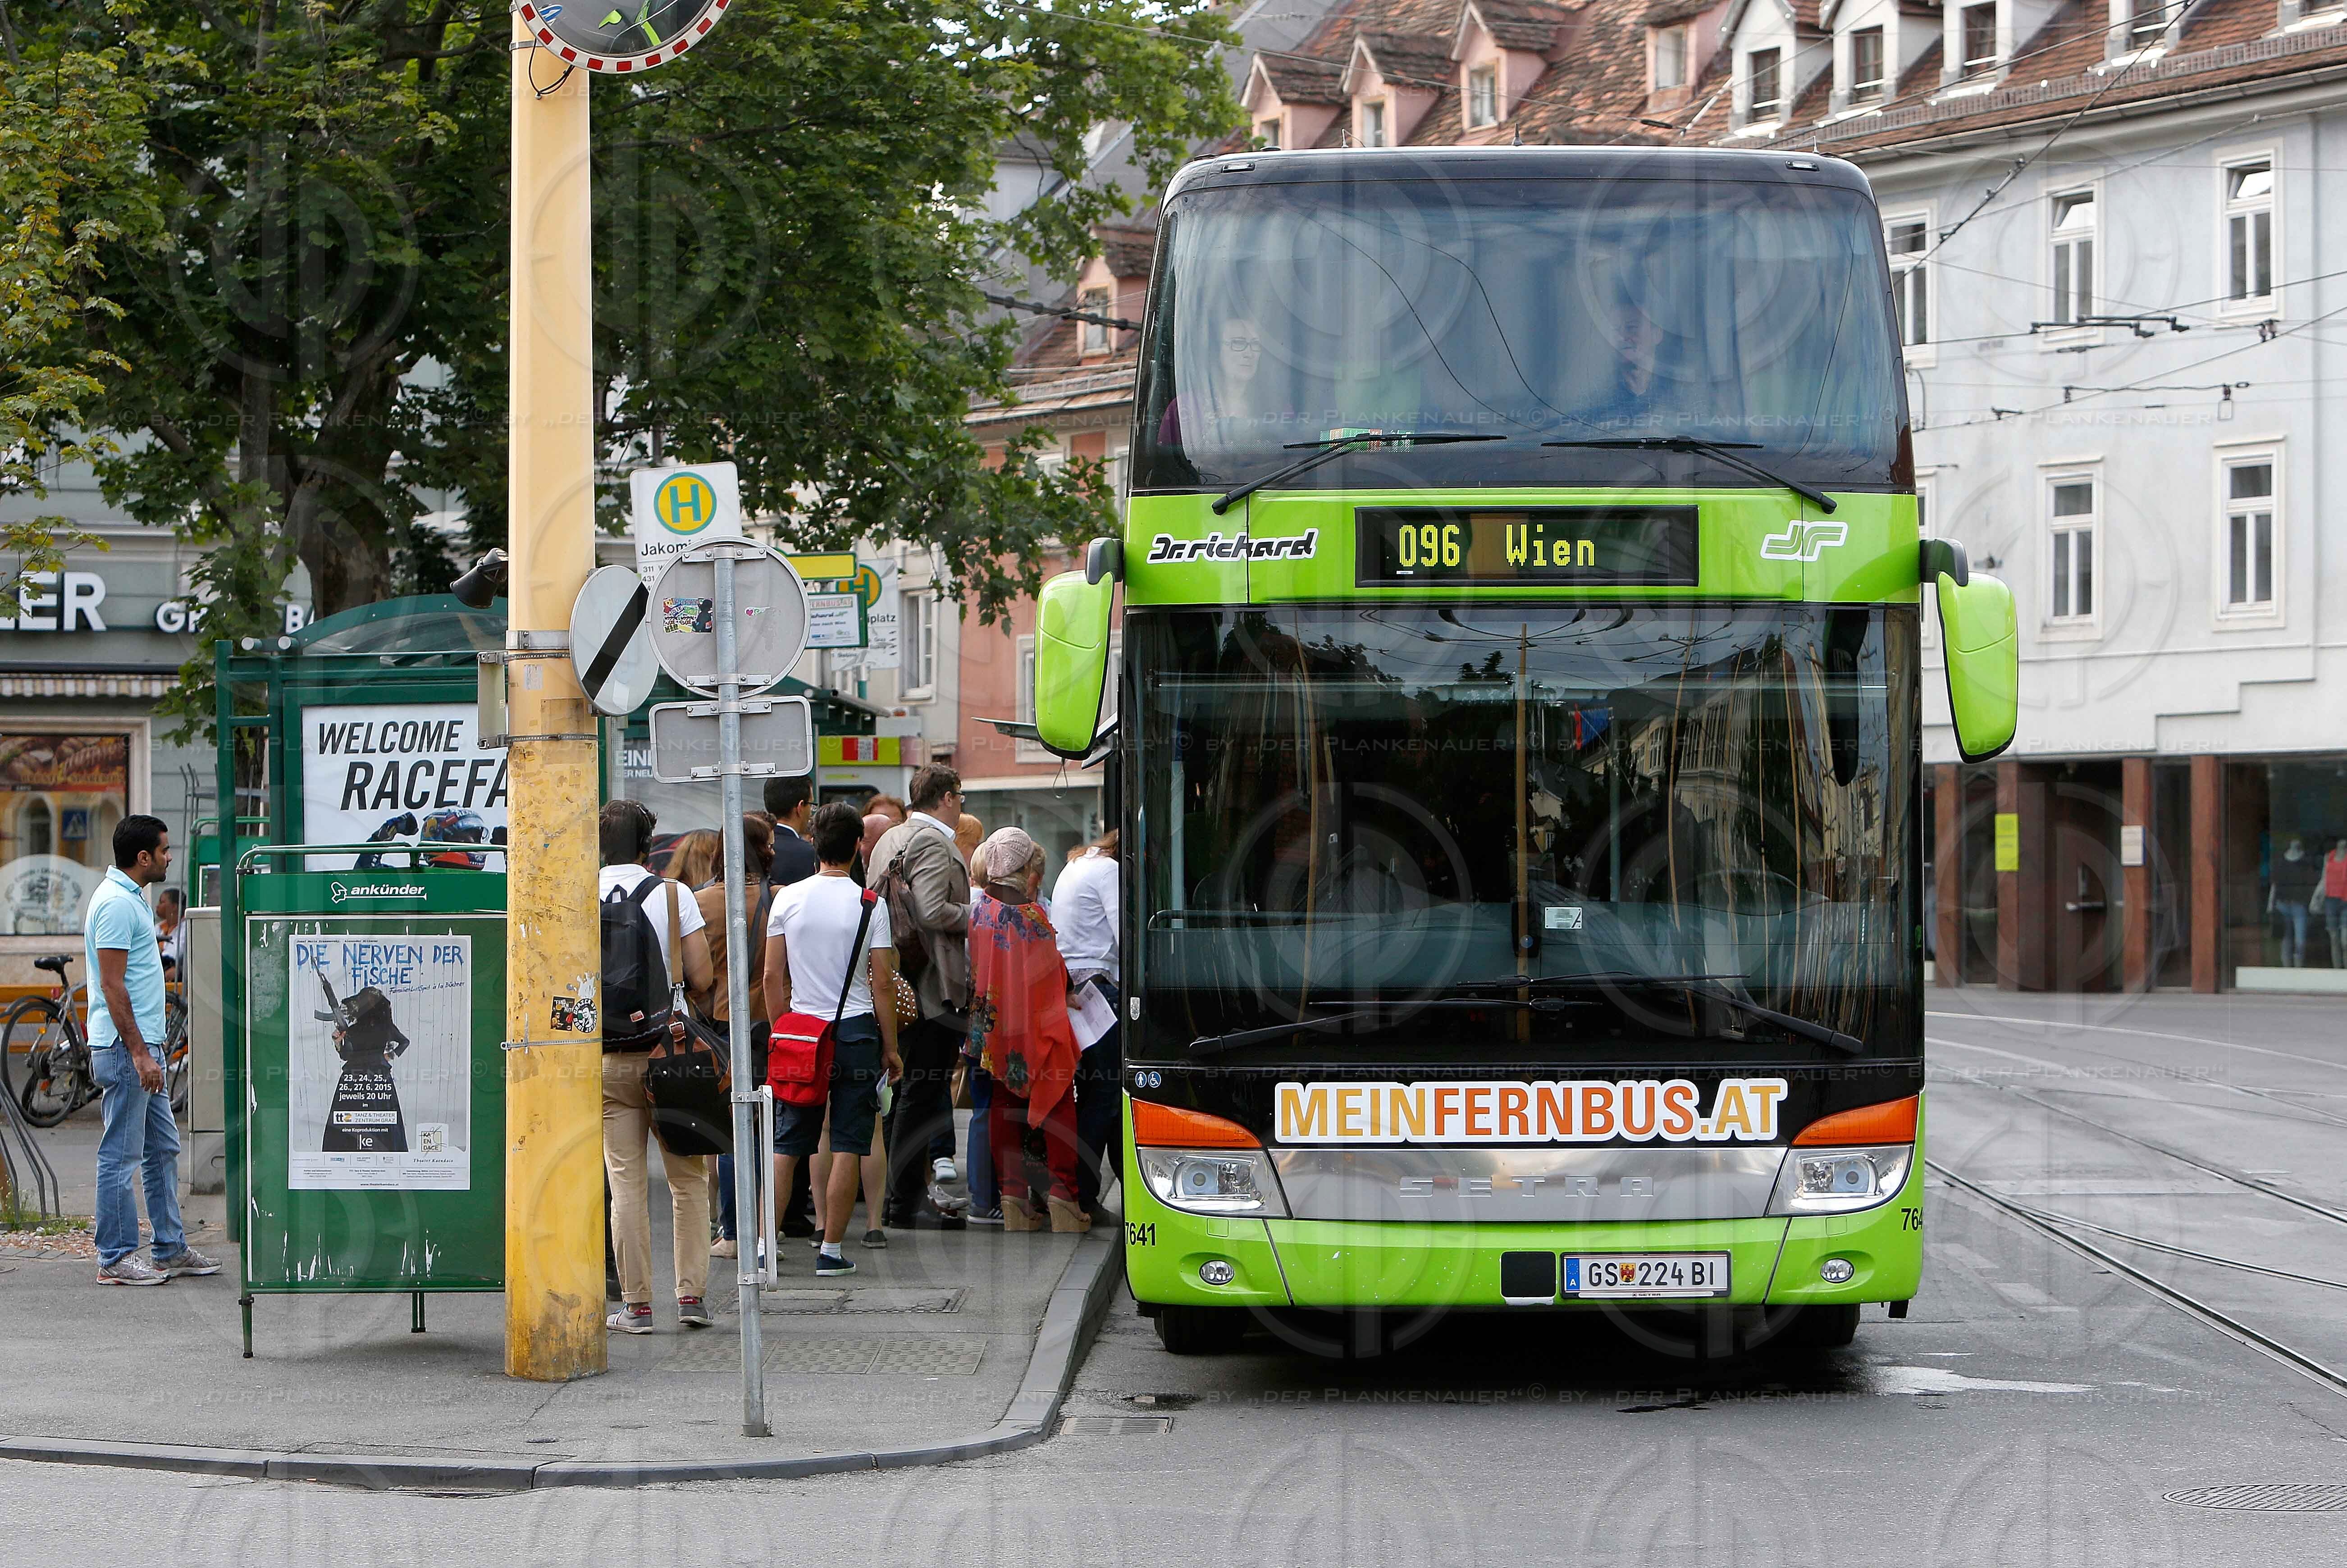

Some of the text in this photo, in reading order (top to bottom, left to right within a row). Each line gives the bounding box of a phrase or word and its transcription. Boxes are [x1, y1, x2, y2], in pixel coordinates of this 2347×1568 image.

[1399, 524, 1594, 567] 096 Wien
[0, 571, 107, 631] ER
[319, 720, 464, 754] WELCOME
[351, 884, 425, 895] ankünder
[296, 944, 464, 967] DIE NERVEN DER
[343, 1074, 387, 1082] 23., 24., 25.,
[339, 1092, 365, 1101] jeweils
[1281, 1085, 1781, 1137] MEINFERNBUS.AT
[1399, 1176, 1654, 1197] SETRA
[1125, 1222, 1155, 1246] 7641
[1589, 1262, 1618, 1286] GS
[1639, 1262, 1684, 1286] 224
